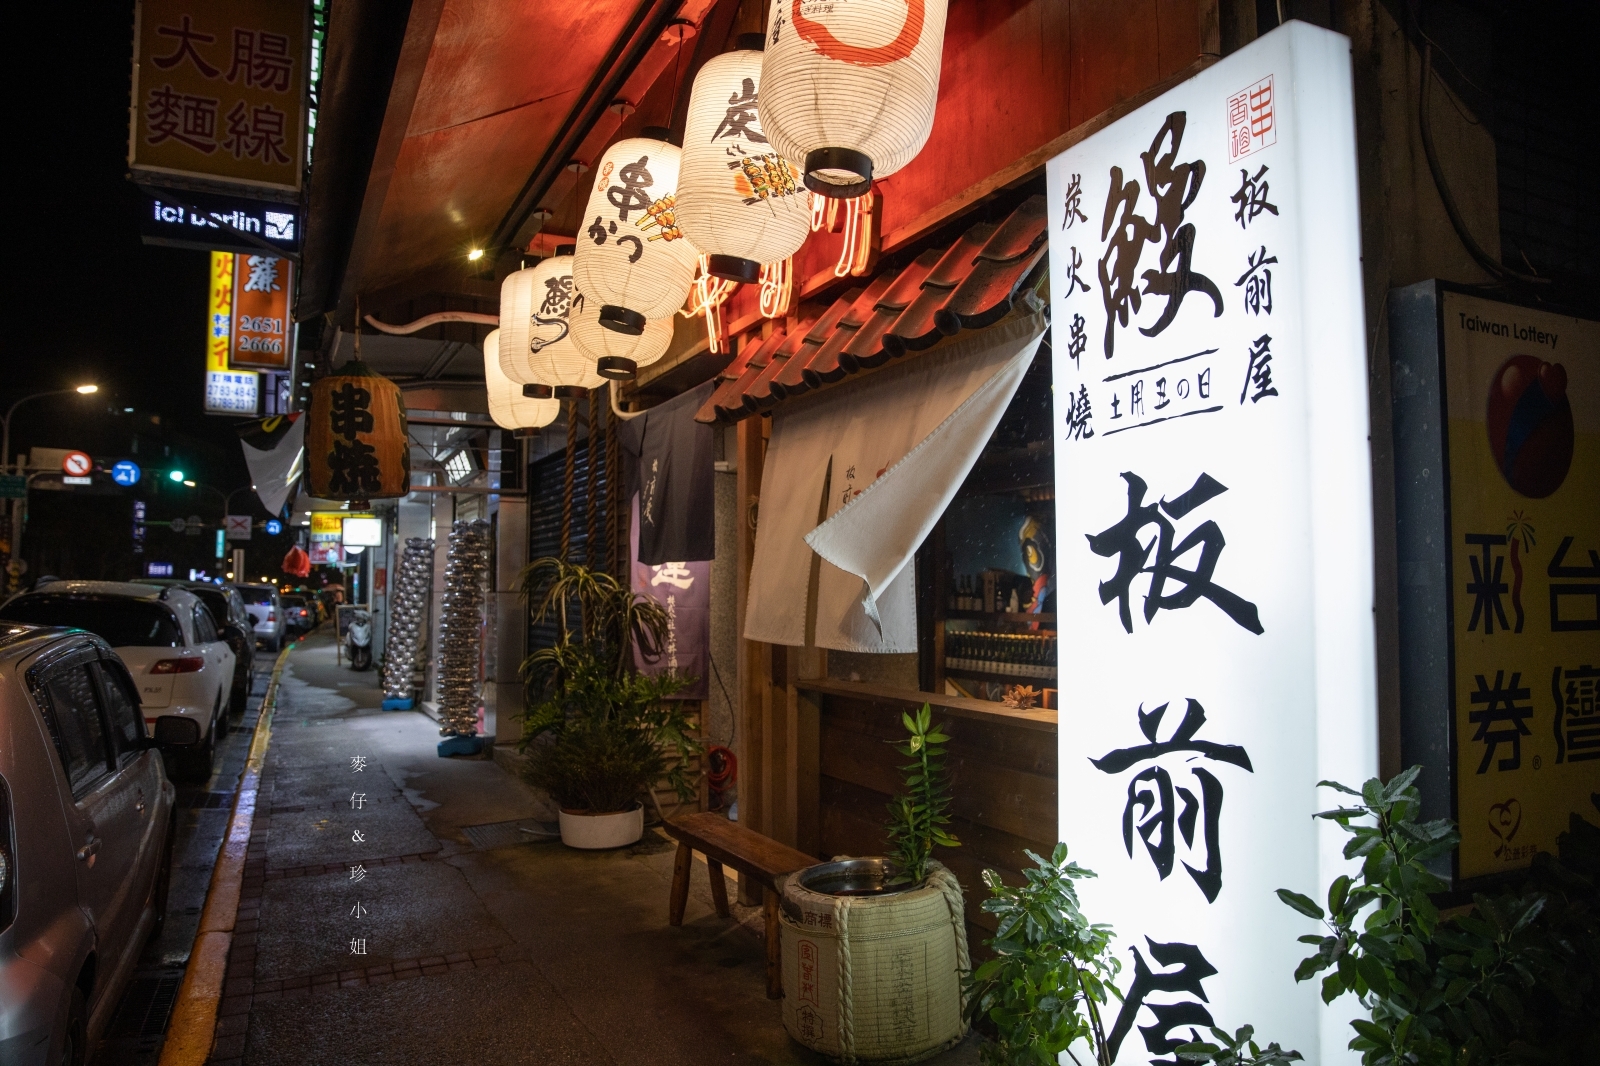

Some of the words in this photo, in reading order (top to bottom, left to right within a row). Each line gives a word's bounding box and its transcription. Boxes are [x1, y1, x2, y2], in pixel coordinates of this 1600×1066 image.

[152, 16, 295, 93] 大腸
[145, 85, 292, 164] 麵線
[711, 77, 769, 144] 炭
[154, 201, 184, 223] ic!
[587, 154, 656, 264] 串かつ
[1098, 110, 1224, 359] 鰻
[1061, 174, 1096, 442] 炭火串燒
[1229, 163, 1280, 407] 板前屋
[238, 336, 282, 354] 2666
[239, 315, 283, 335] 2651
[1459, 312, 1509, 337] Taiwan
[1513, 323, 1559, 349] Lottery
[1109, 366, 1212, 421] 土用丑の日
[1084, 471, 1265, 1066] 板前屋
[803, 910, 833, 929] 商標
